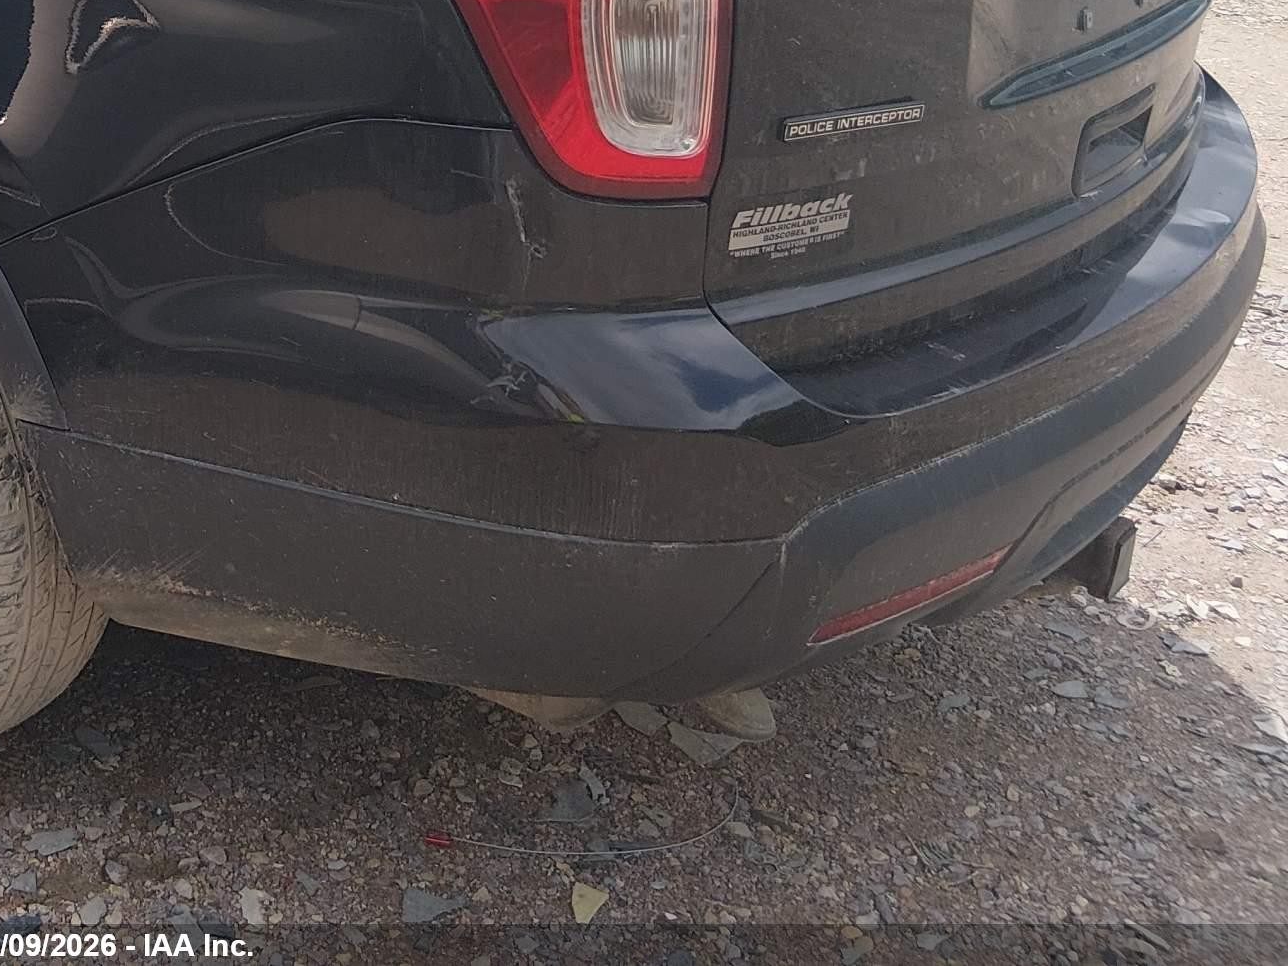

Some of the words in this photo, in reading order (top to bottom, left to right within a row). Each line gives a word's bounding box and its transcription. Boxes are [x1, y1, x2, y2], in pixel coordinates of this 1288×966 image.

[789, 120, 834, 137] POLICE
[836, 108, 921, 130] INTERCEPTOR
[732, 192, 853, 228] Fillback
[732, 217, 818, 238] HIGHLAND-RICHLAND
[818, 211, 849, 224] CENTER
[809, 224, 820, 234] WI
[761, 244, 775, 254] THE
